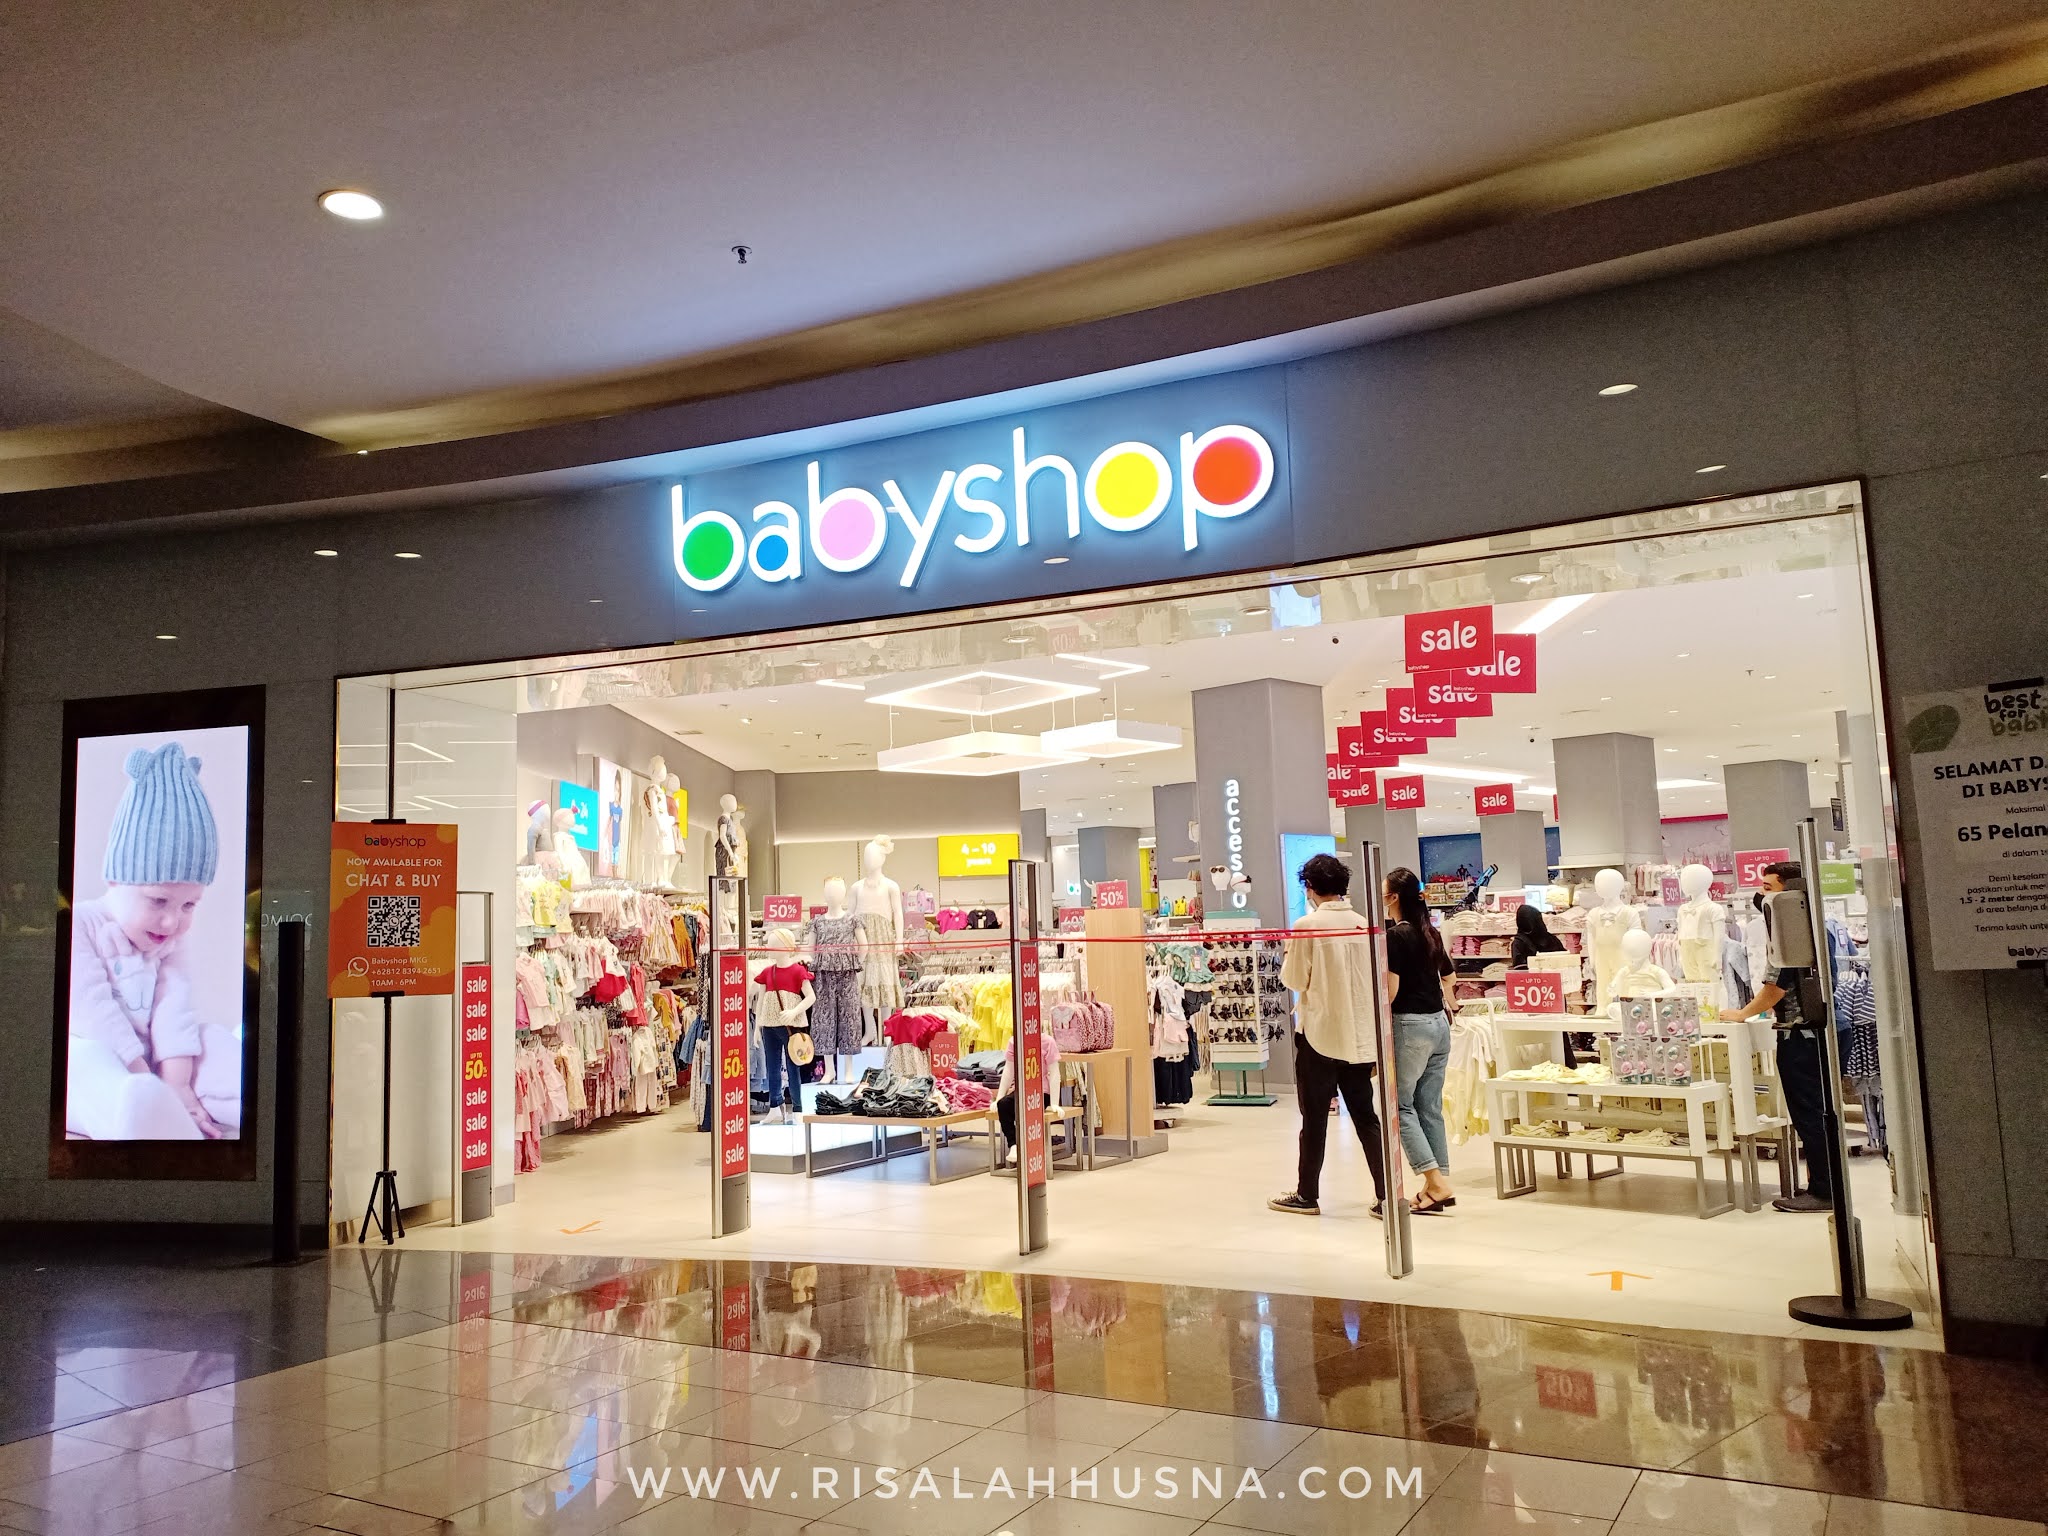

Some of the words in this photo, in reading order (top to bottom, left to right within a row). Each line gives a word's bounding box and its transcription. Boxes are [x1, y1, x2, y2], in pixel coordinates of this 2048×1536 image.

[671, 424, 1275, 590] babyshop
[1420, 620, 1477, 652] sale
[1983, 689, 2042, 714] best
[1999, 709, 2026, 722] for
[1327, 763, 1352, 780] ale
[1933, 757, 2025, 780] SELAMAT
[2029, 756, 2048, 770] D
[1391, 785, 1418, 801] sale
[1962, 783, 1985, 798] DI
[1481, 792, 1508, 808] sale
[2005, 804, 2046, 814] Maksimal
[364, 834, 426, 849] babyshop
[1957, 826, 1982, 842] 65
[1988, 823, 2048, 840] Pelan
[346, 858, 370, 866] NOW
[373, 858, 421, 867] AVAILABLE
[423, 858, 443, 867] FOR
[2012, 850, 2039, 858] dalam
[345, 873, 390, 887] CHAT
[395, 874, 406, 887] &
[411, 874, 441, 887] BUY
[1743, 861, 1777, 882] 50
[1988, 874, 2011, 882] Demi
[1100, 890, 1124, 907] 50%
[1665, 887, 1679, 901] 50%
[1967, 886, 2002, 895] pastikan
[2004, 884, 2029, 892] untuk
[1988, 895, 2015, 903] meter
[768, 904, 797, 918] 50%
[2007, 904, 2039, 913] belanja
[1975, 924, 2004, 932] Terima
[2005, 923, 2028, 931] kasih
[371, 957, 408, 966] Babyshop
[409, 956, 428, 964] MKG
[1023, 959, 1036, 978] sale
[371, 968, 400, 976] +62812
[402, 967, 421, 975] 8394
[723, 966, 743, 985] sale
[371, 979, 393, 987] 10AM
[399, 978, 417, 986] 6PM
[466, 975, 487, 993] sale
[723, 993, 743, 1012] sale
[1023, 987, 1037, 1007] sale
[1513, 985, 1556, 1007] 50%
[466, 1000, 487, 1018] sale
[466, 1023, 487, 1042] sale
[723, 1018, 743, 1038] sale
[1024, 1014, 1038, 1035] sale
[932, 1053, 957, 1068] 50%
[466, 1087, 487, 1106] sale
[725, 1086, 744, 1108] sale
[1027, 1088, 1040, 1111] sale
[465, 1112, 487, 1132] sale
[725, 1114, 744, 1135] sale
[1027, 1119, 1041, 1142] sale
[465, 1139, 487, 1159] sale
[725, 1143, 745, 1165] sale
[1028, 1150, 1042, 1173] sale
